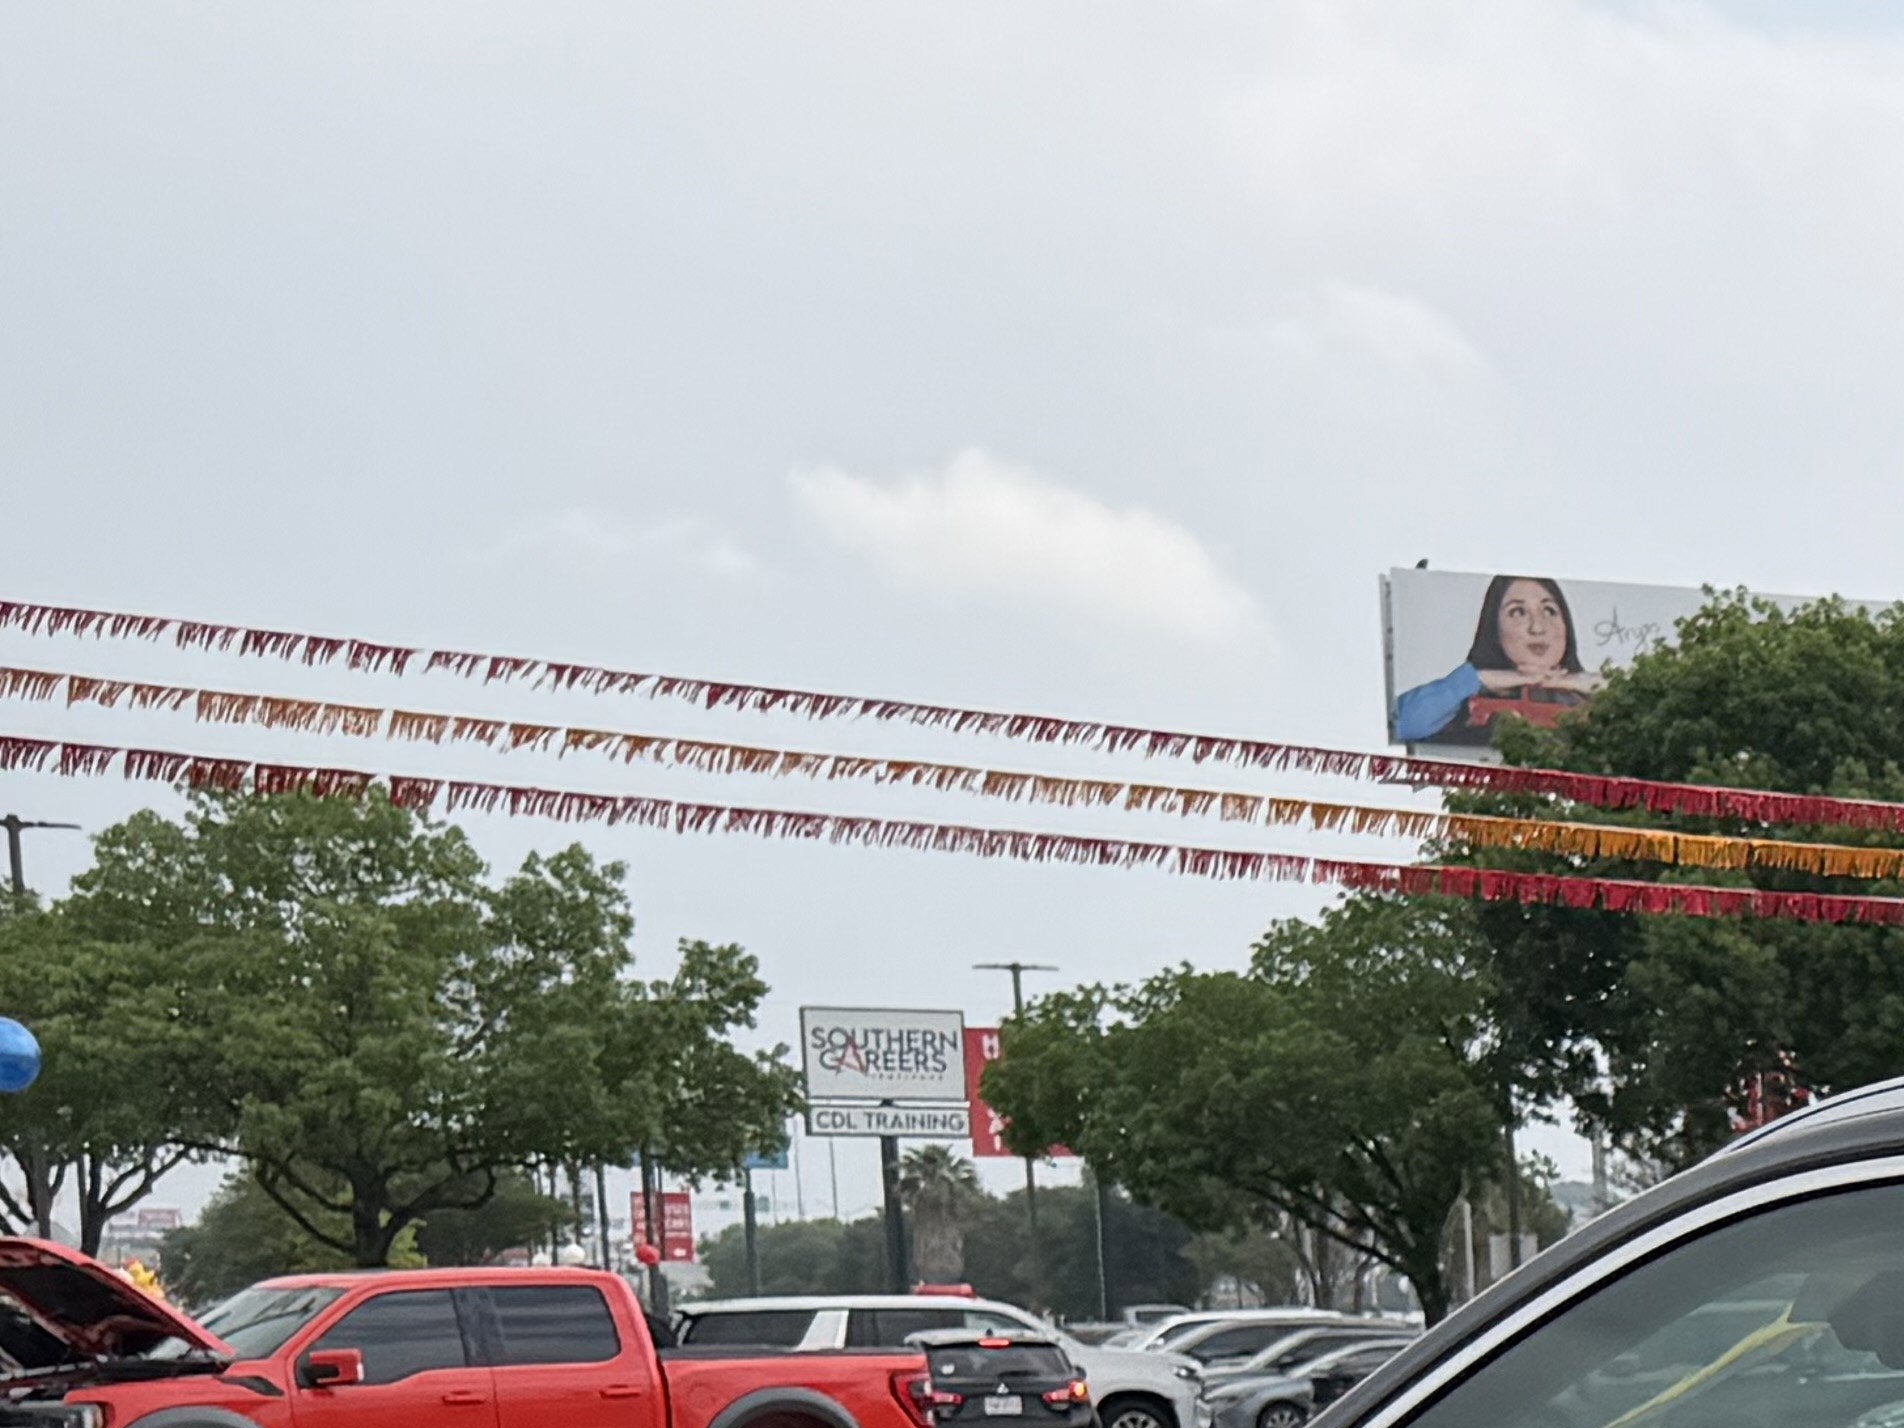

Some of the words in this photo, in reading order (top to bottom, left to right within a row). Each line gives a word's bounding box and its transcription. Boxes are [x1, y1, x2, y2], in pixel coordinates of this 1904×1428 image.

[811, 1026, 958, 1051] SOUTHERN
[819, 1042, 948, 1075] CAREERS
[816, 1111, 857, 1130] CDL
[864, 1112, 965, 1131] TRAINING
